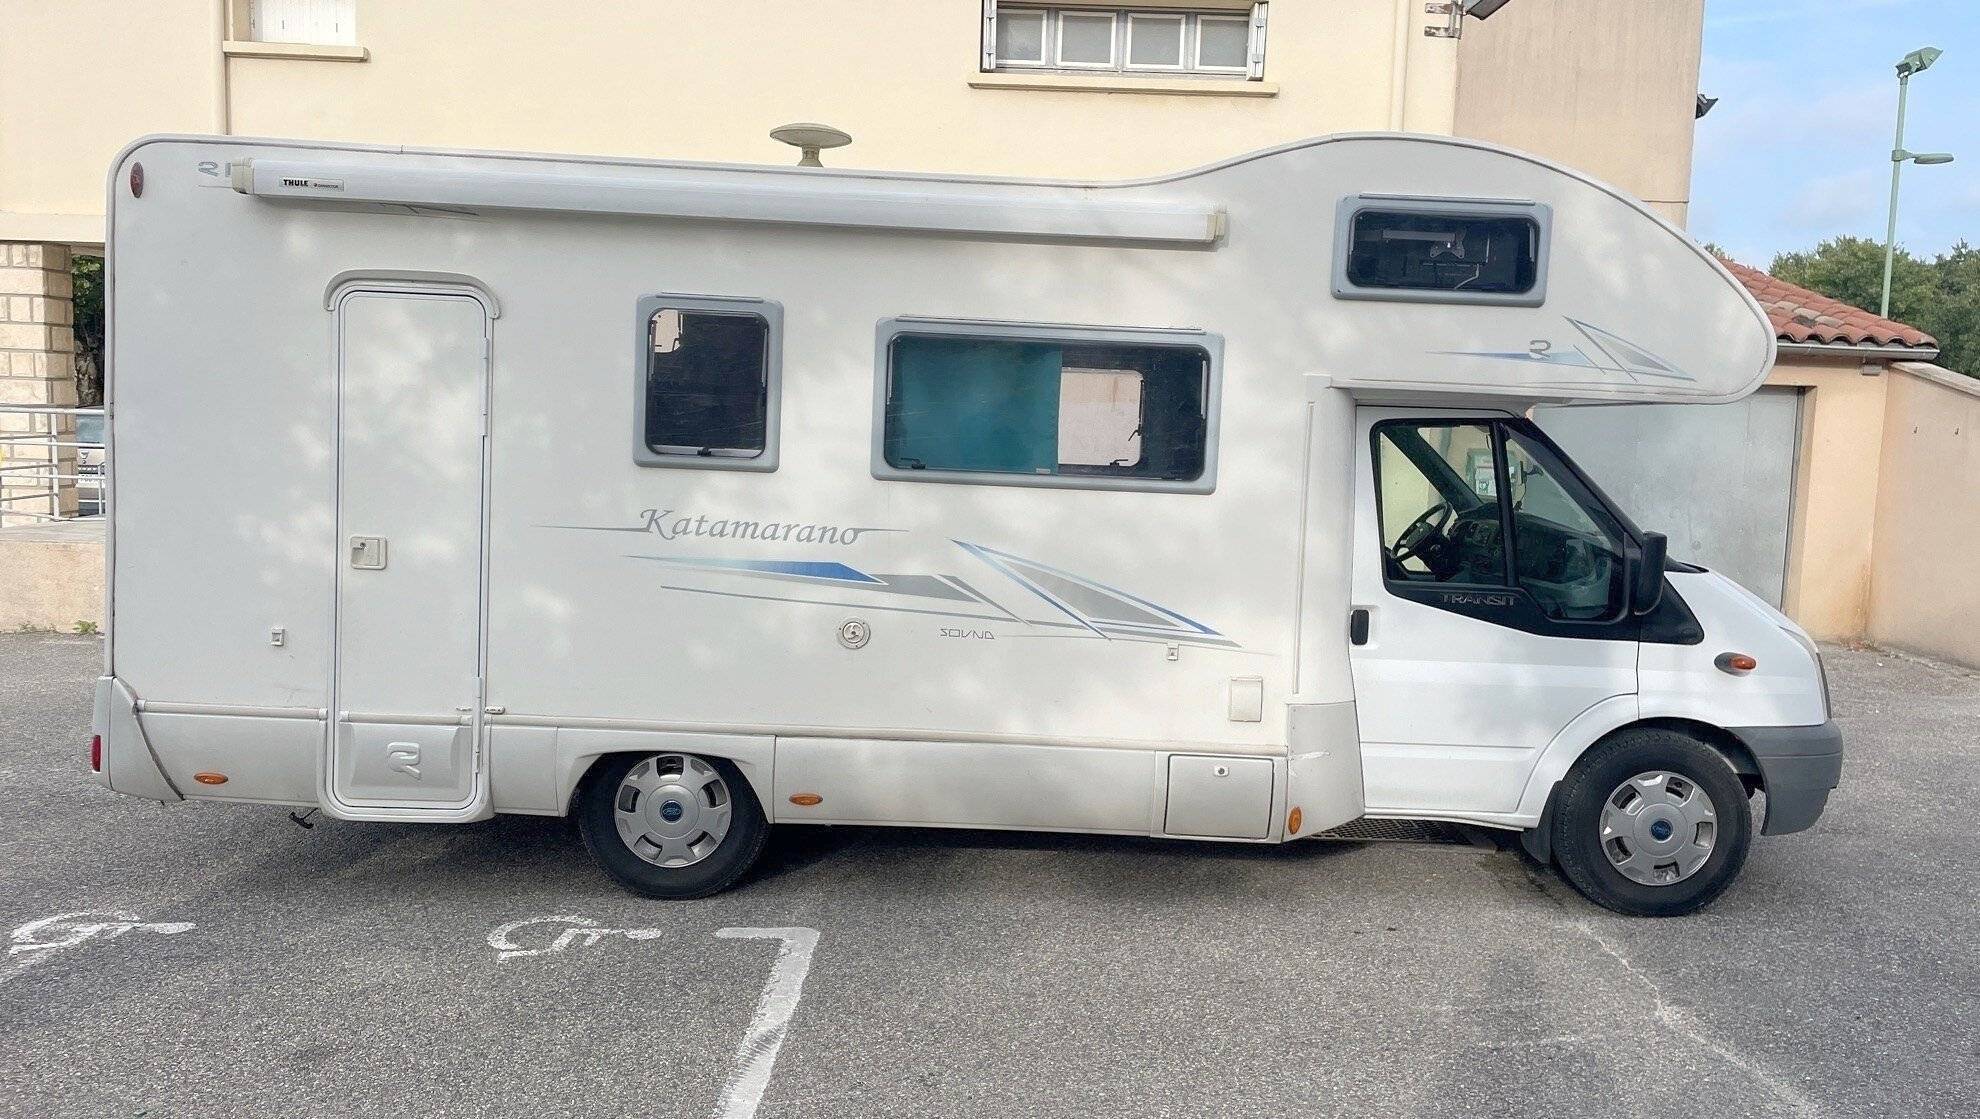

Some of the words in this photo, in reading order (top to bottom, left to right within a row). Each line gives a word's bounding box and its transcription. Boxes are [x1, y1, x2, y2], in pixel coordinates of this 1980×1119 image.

[283, 179, 308, 187] THULE
[640, 508, 864, 545] Katamarano
[1440, 592, 1514, 606] TRANSIT
